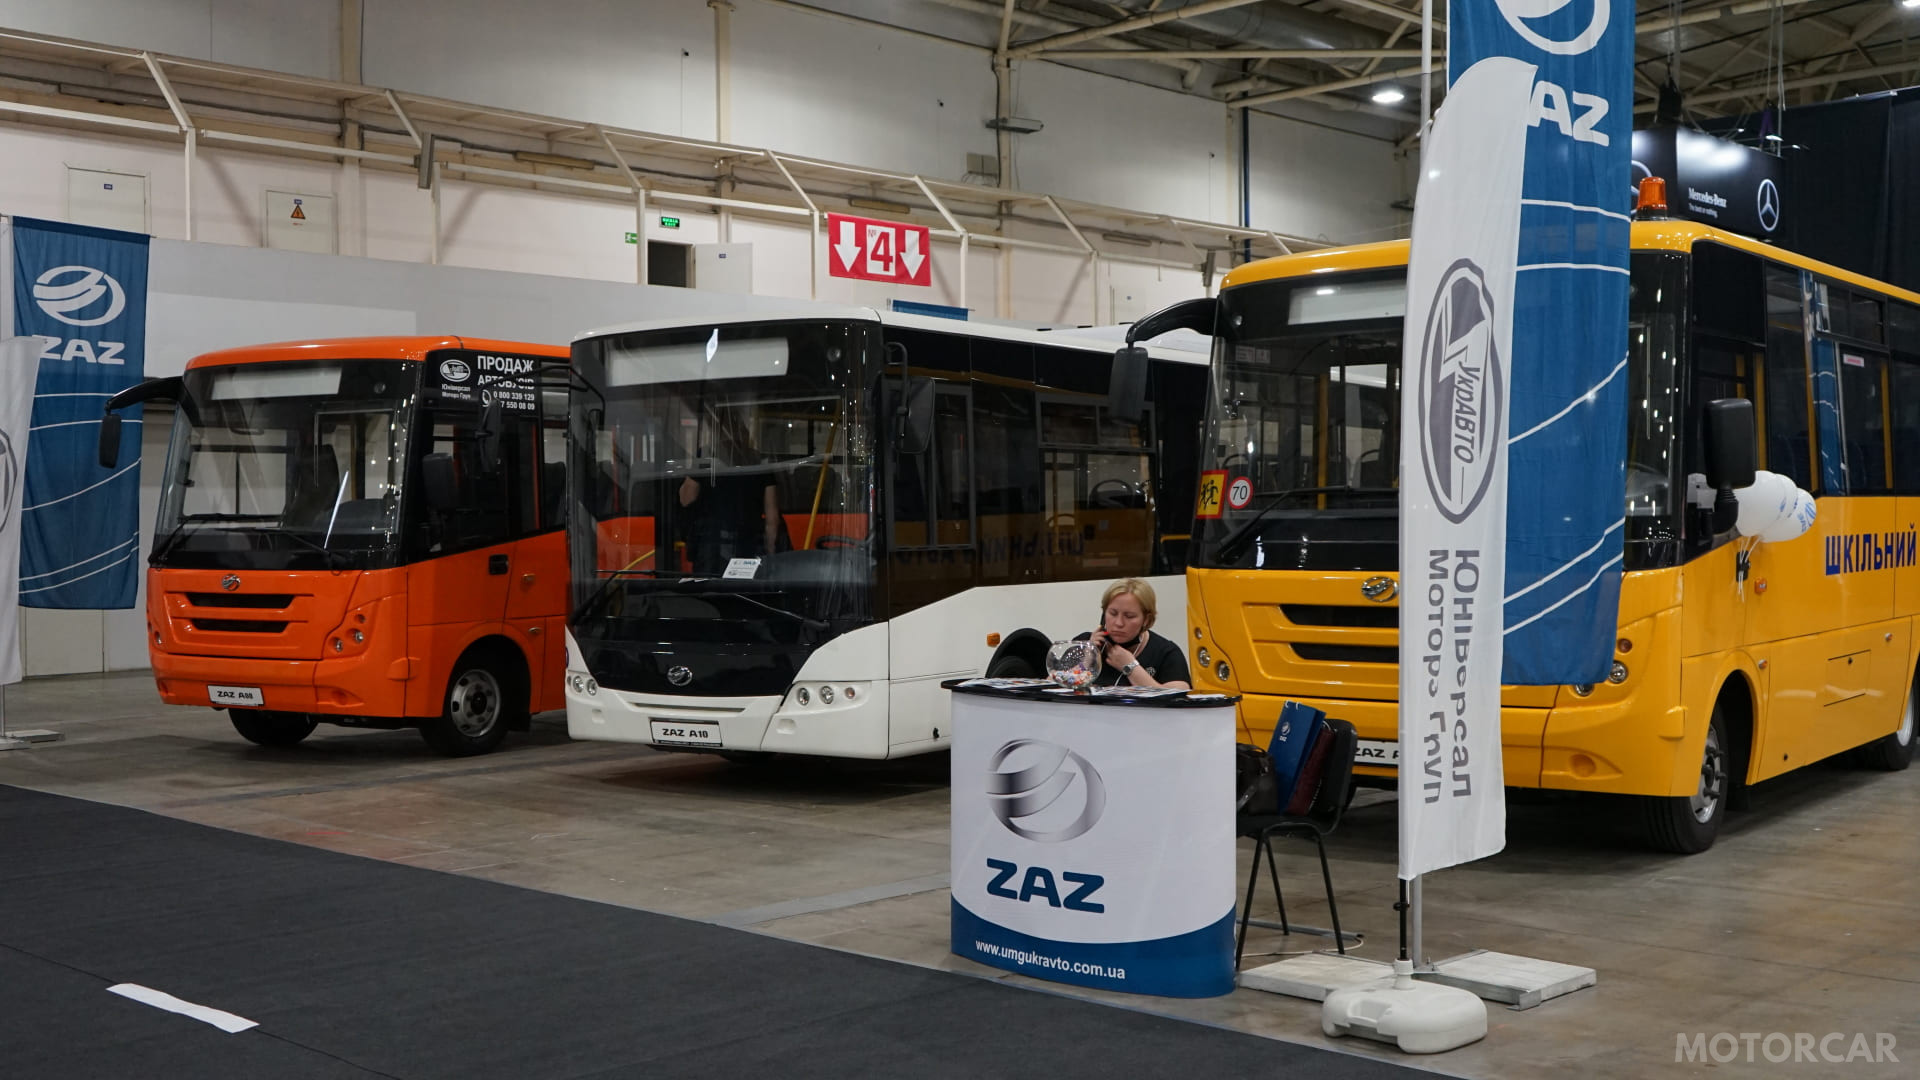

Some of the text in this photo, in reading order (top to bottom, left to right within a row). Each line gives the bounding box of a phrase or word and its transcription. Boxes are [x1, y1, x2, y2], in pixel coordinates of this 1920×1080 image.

[1527, 80, 1610, 147] AZ
[1688, 187, 1726, 208] Mercedes-Benz
[870, 231, 893, 272] 4
[31, 334, 125, 365] ZAZ
[477, 355, 533, 374] ПРОДАЖ
[1232, 485, 1248, 501] 70
[1825, 521, 1916, 576] ШКІЛЬНИЙ
[662, 729, 708, 738] ZAZ A10
[986, 857, 1105, 914] ZAZ
[975, 939, 1126, 980] www.umgukravto.com.ua
